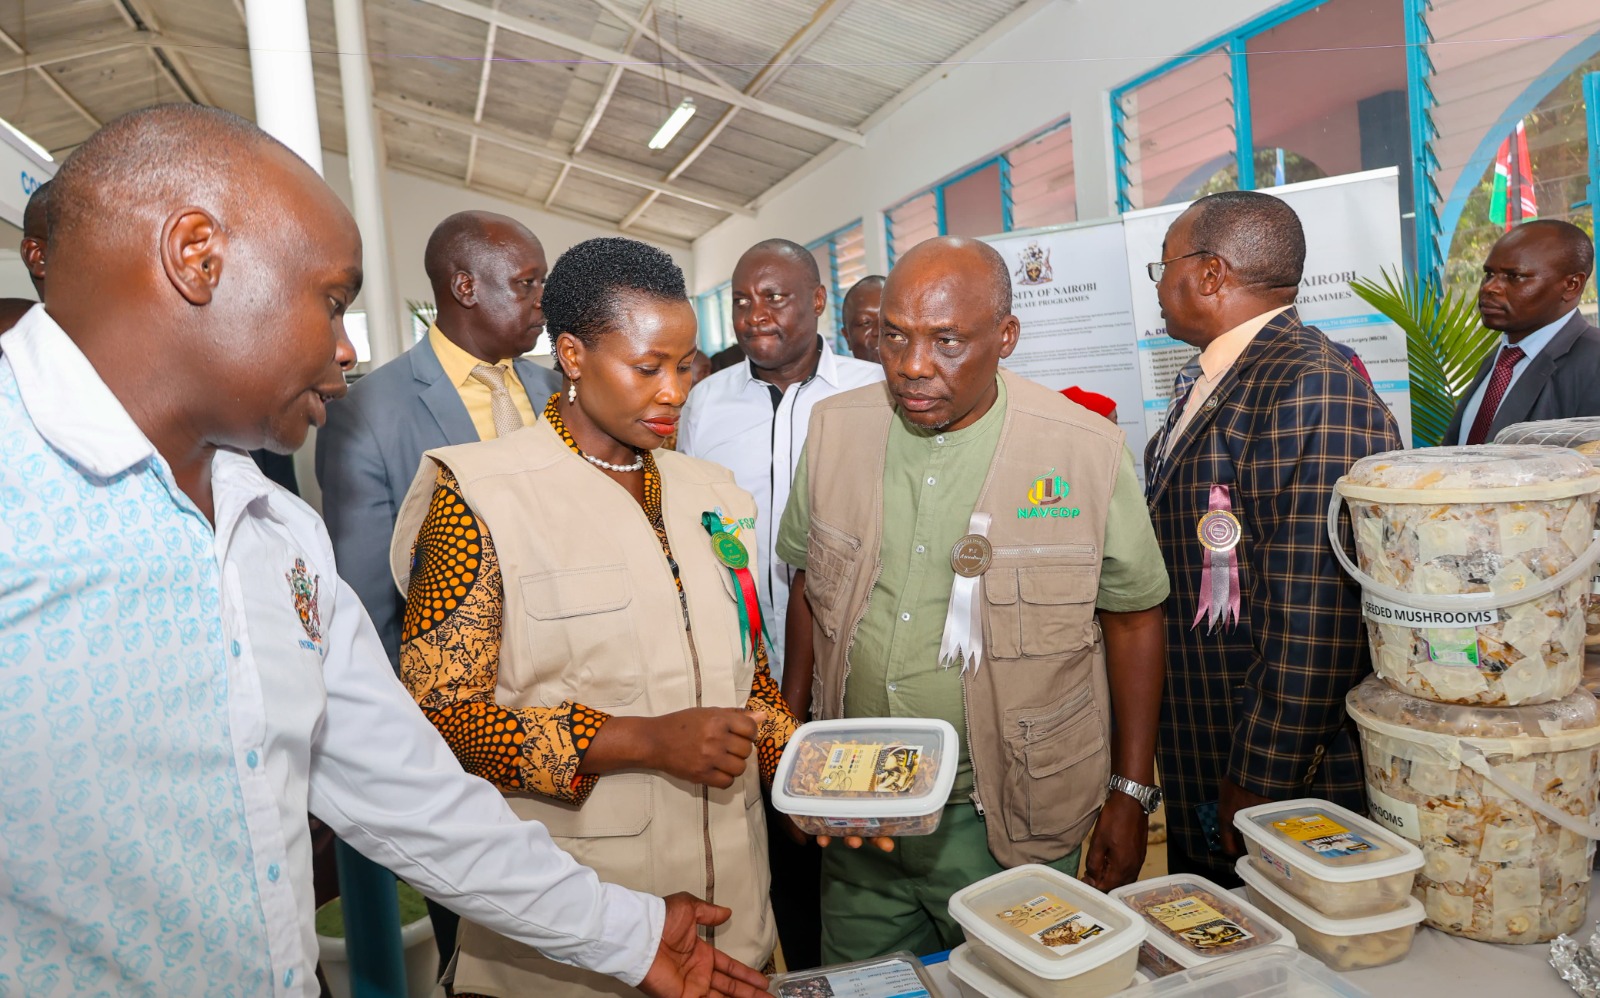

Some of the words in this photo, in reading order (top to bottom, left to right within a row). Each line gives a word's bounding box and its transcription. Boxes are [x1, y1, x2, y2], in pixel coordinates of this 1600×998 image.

[1037, 288, 1052, 297] OF
[1053, 282, 1097, 295] NAIROBI
[1038, 295, 1090, 306] PROGRAMMES
[1017, 507, 1081, 519] NAVCDP
[1365, 601, 1392, 618] SEEDED
[1394, 609, 1492, 624] MUSHROOMS
